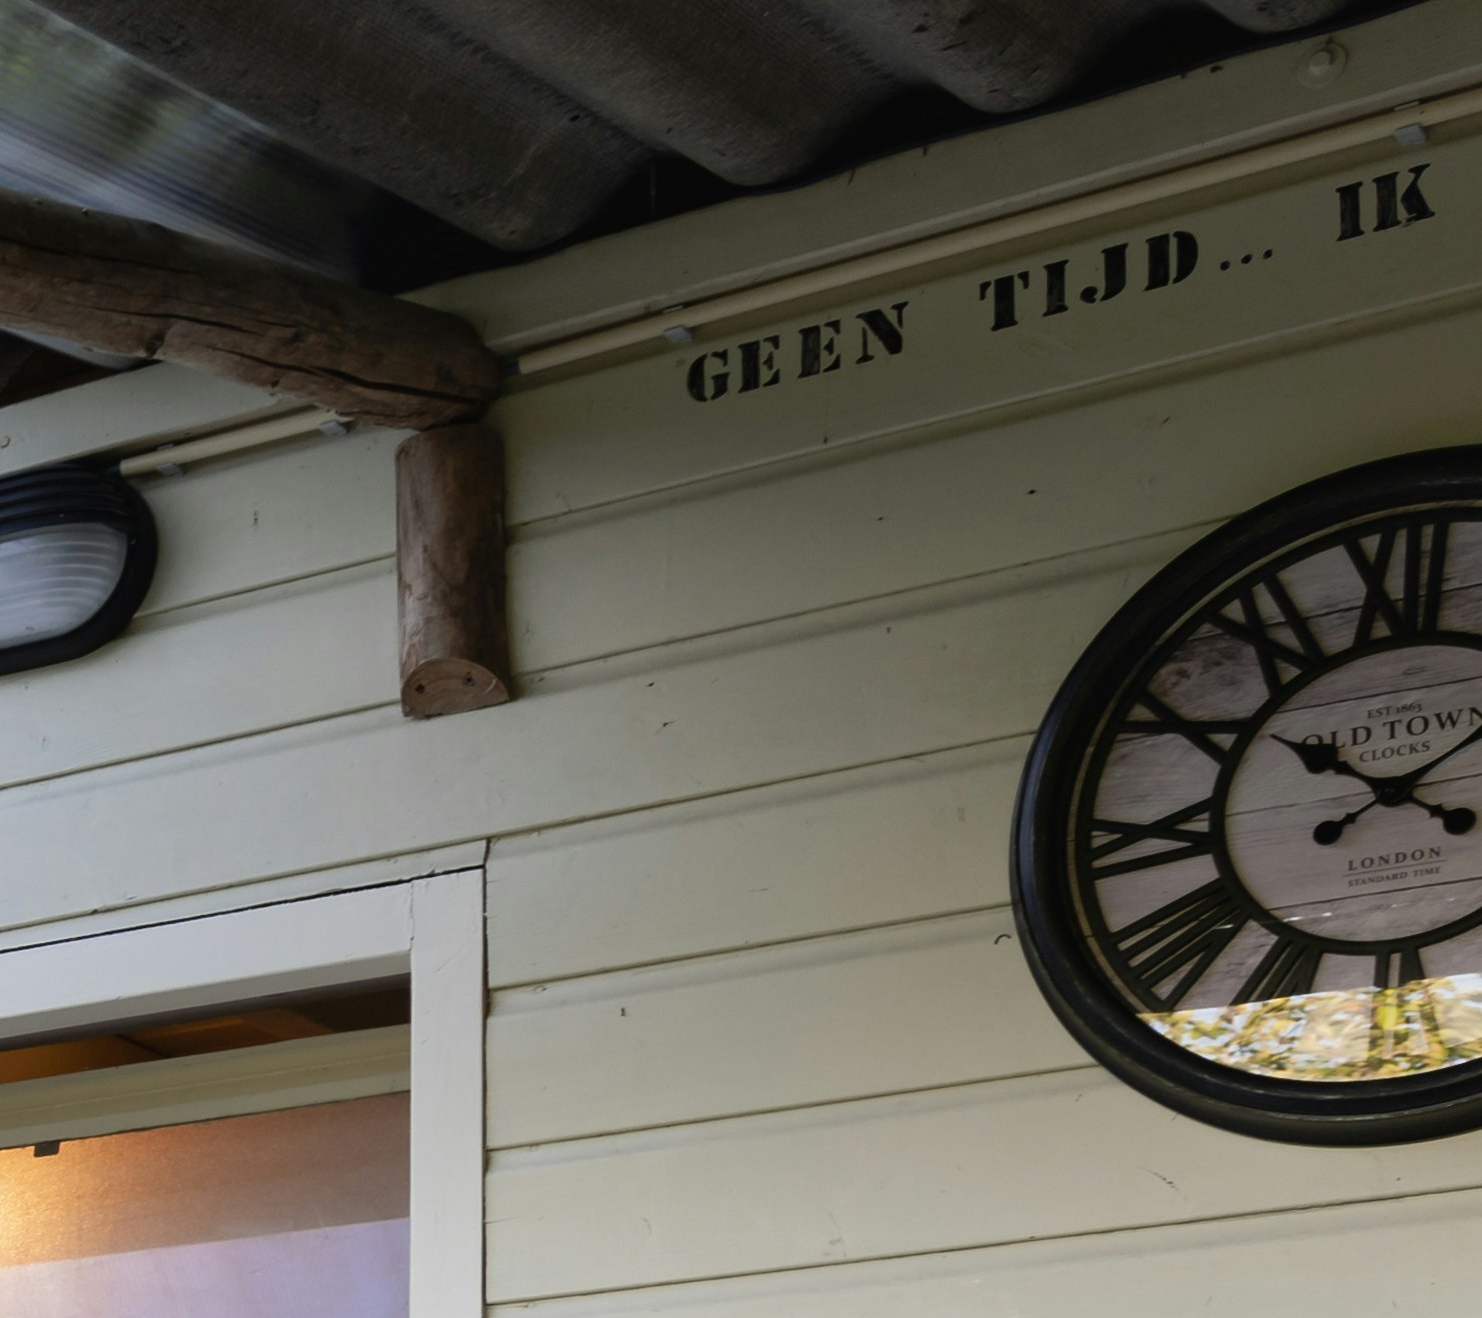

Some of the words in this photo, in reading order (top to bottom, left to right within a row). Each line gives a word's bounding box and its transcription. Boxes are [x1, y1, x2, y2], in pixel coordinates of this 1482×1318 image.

[685, 301, 910, 403] GEEN
[979, 230, 1274, 332] TIJD...
[1336, 164, 1436, 241] IK
[1344, 519, 1450, 647] XII
[1204, 573, 1327, 697] XI
[1115, 690, 1250, 767] X
[1367, 706, 1393, 720] EST
[1395, 702, 1423, 715] 1863
[1382, 706, 1482, 741] TOWN
[1358, 740, 1431, 763] CLOCKS
[1347, 846, 1442, 872] LONDON
[1347, 871, 1408, 887] STANDARD
[1413, 866, 1442, 878] TIME
